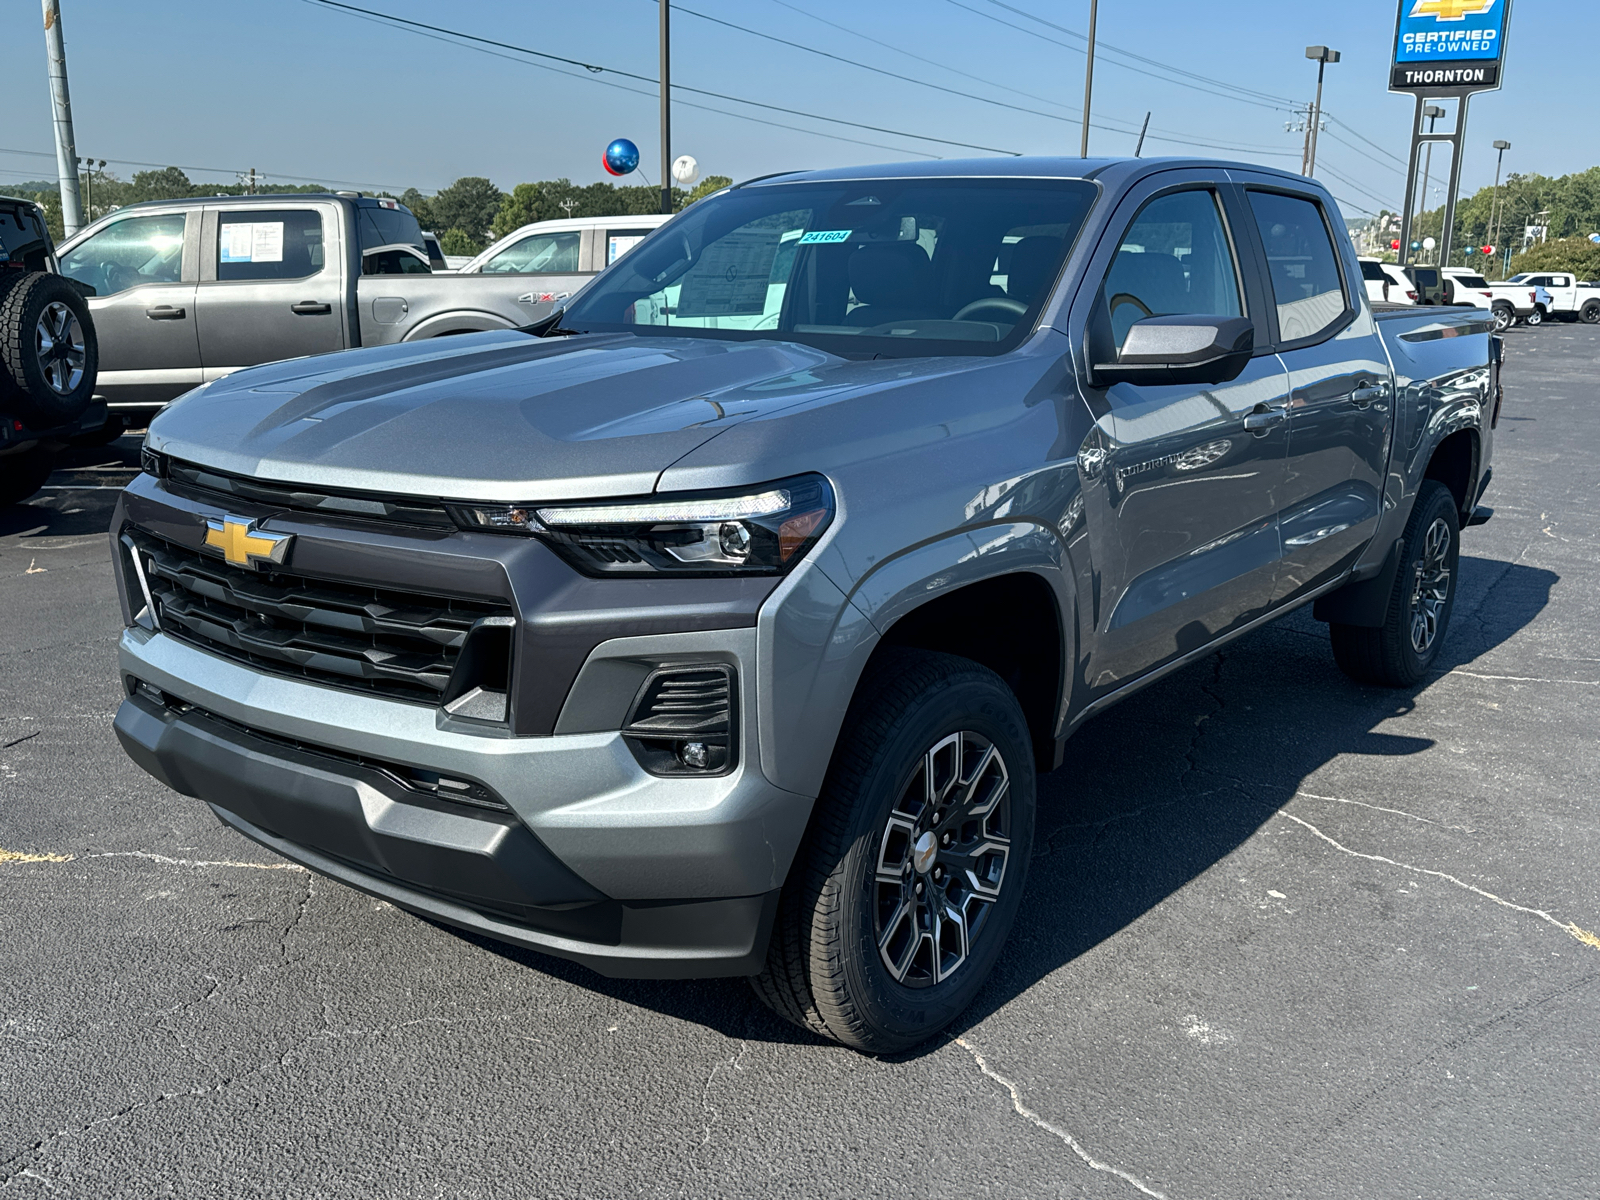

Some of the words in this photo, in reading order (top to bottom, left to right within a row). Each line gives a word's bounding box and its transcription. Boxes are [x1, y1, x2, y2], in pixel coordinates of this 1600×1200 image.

[1402, 29, 1496, 43] CERTIFIED
[1406, 41, 1490, 53] PRE-OWNED
[1405, 69, 1484, 83] THORNTON
[802, 232, 848, 242] 241604
